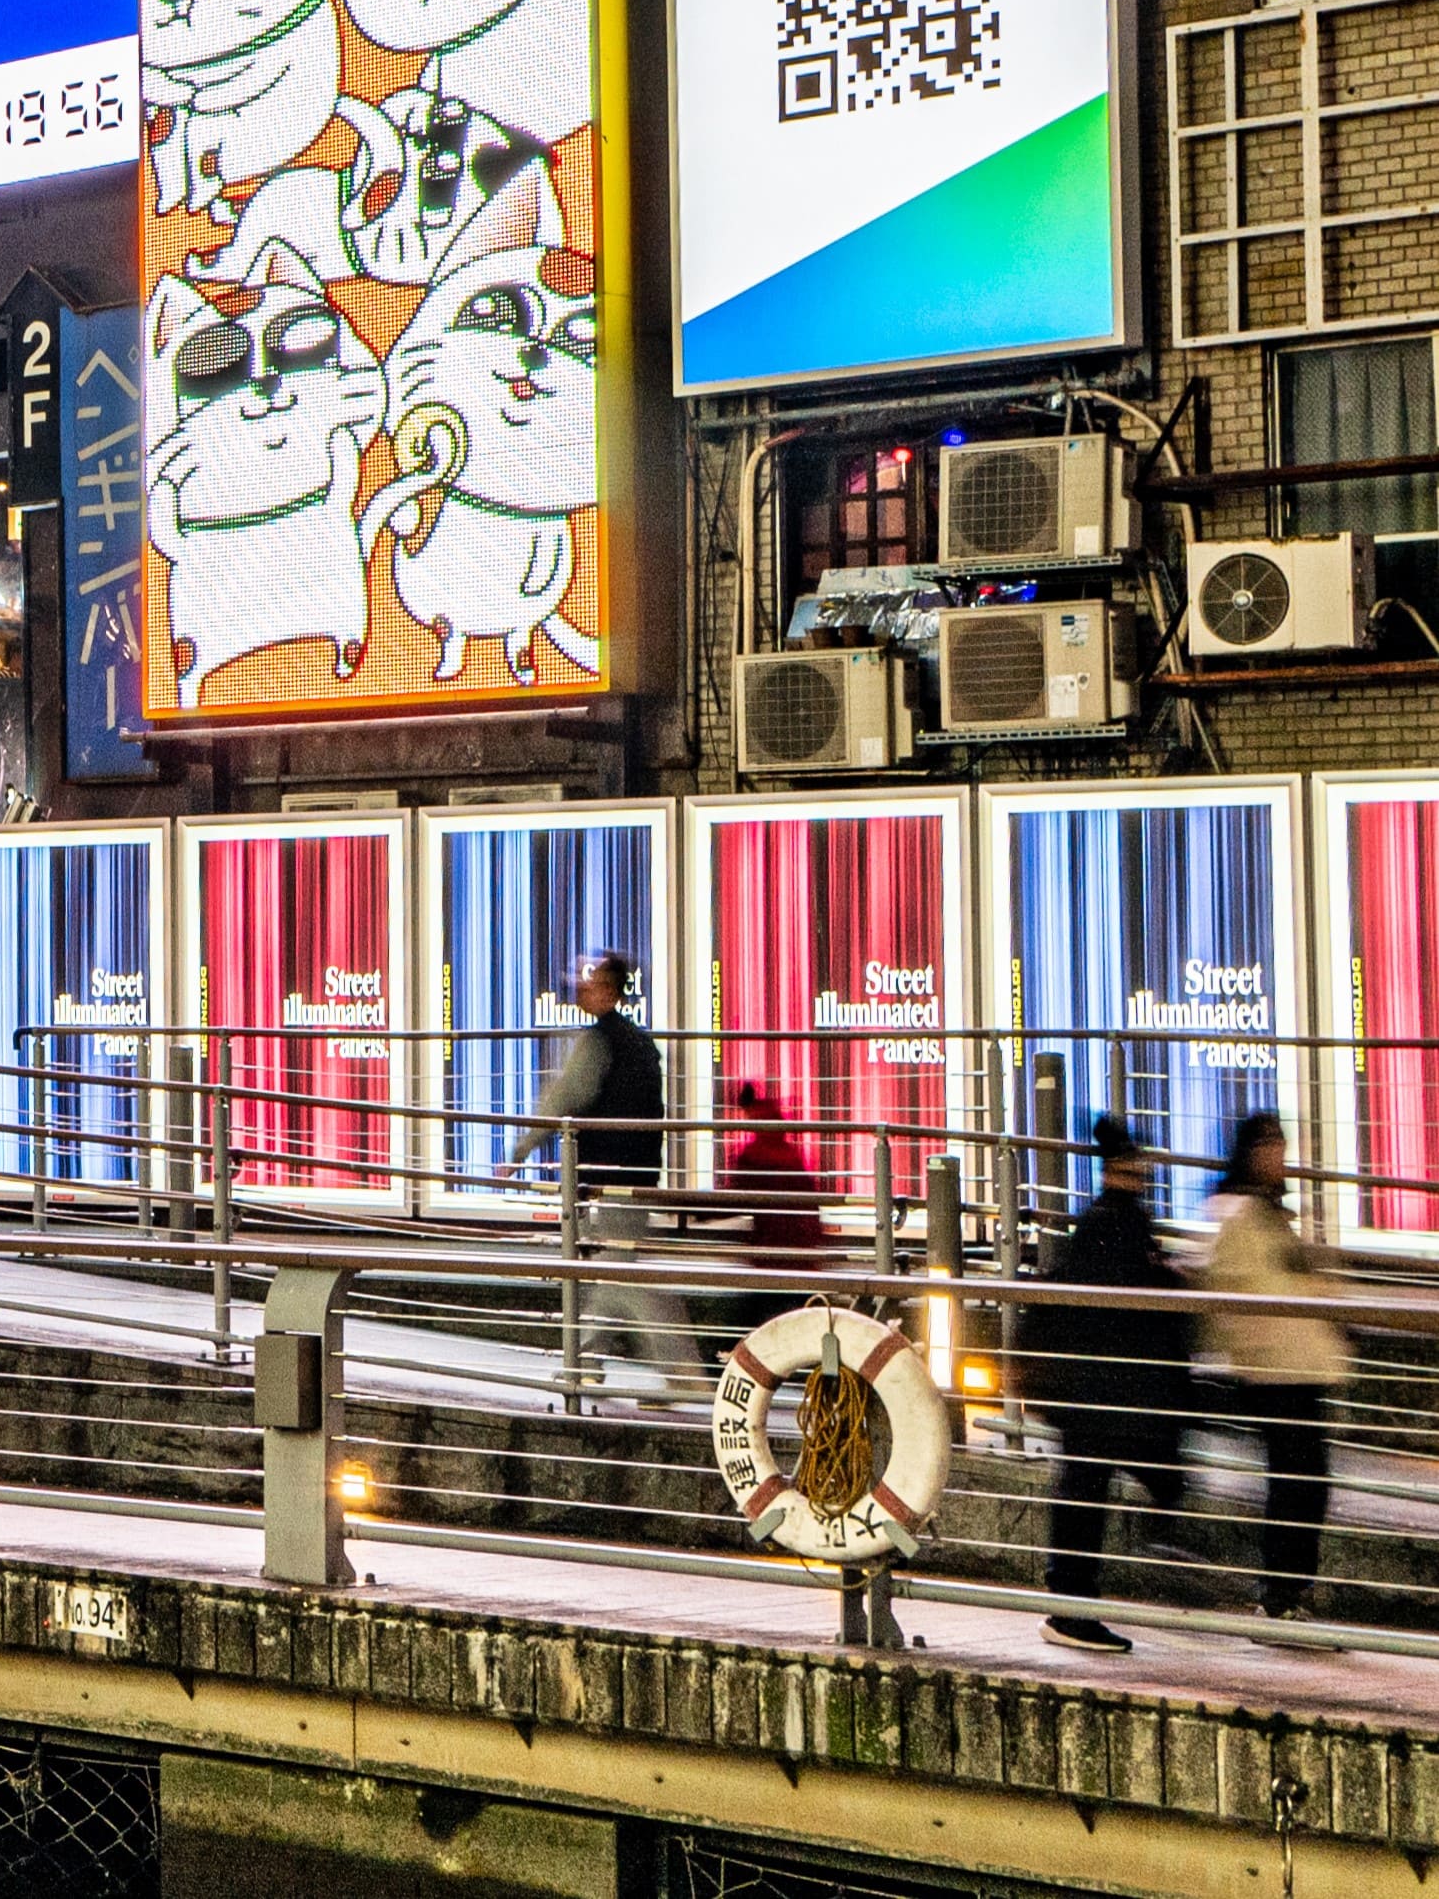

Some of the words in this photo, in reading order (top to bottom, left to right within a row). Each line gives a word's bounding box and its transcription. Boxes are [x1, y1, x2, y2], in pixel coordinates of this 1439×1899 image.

[21, 319, 53, 449] 2F
[91, 968, 144, 998] Street
[324, 966, 382, 998] Street
[864, 960, 935, 997] Street
[1184, 958, 1263, 996] Street
